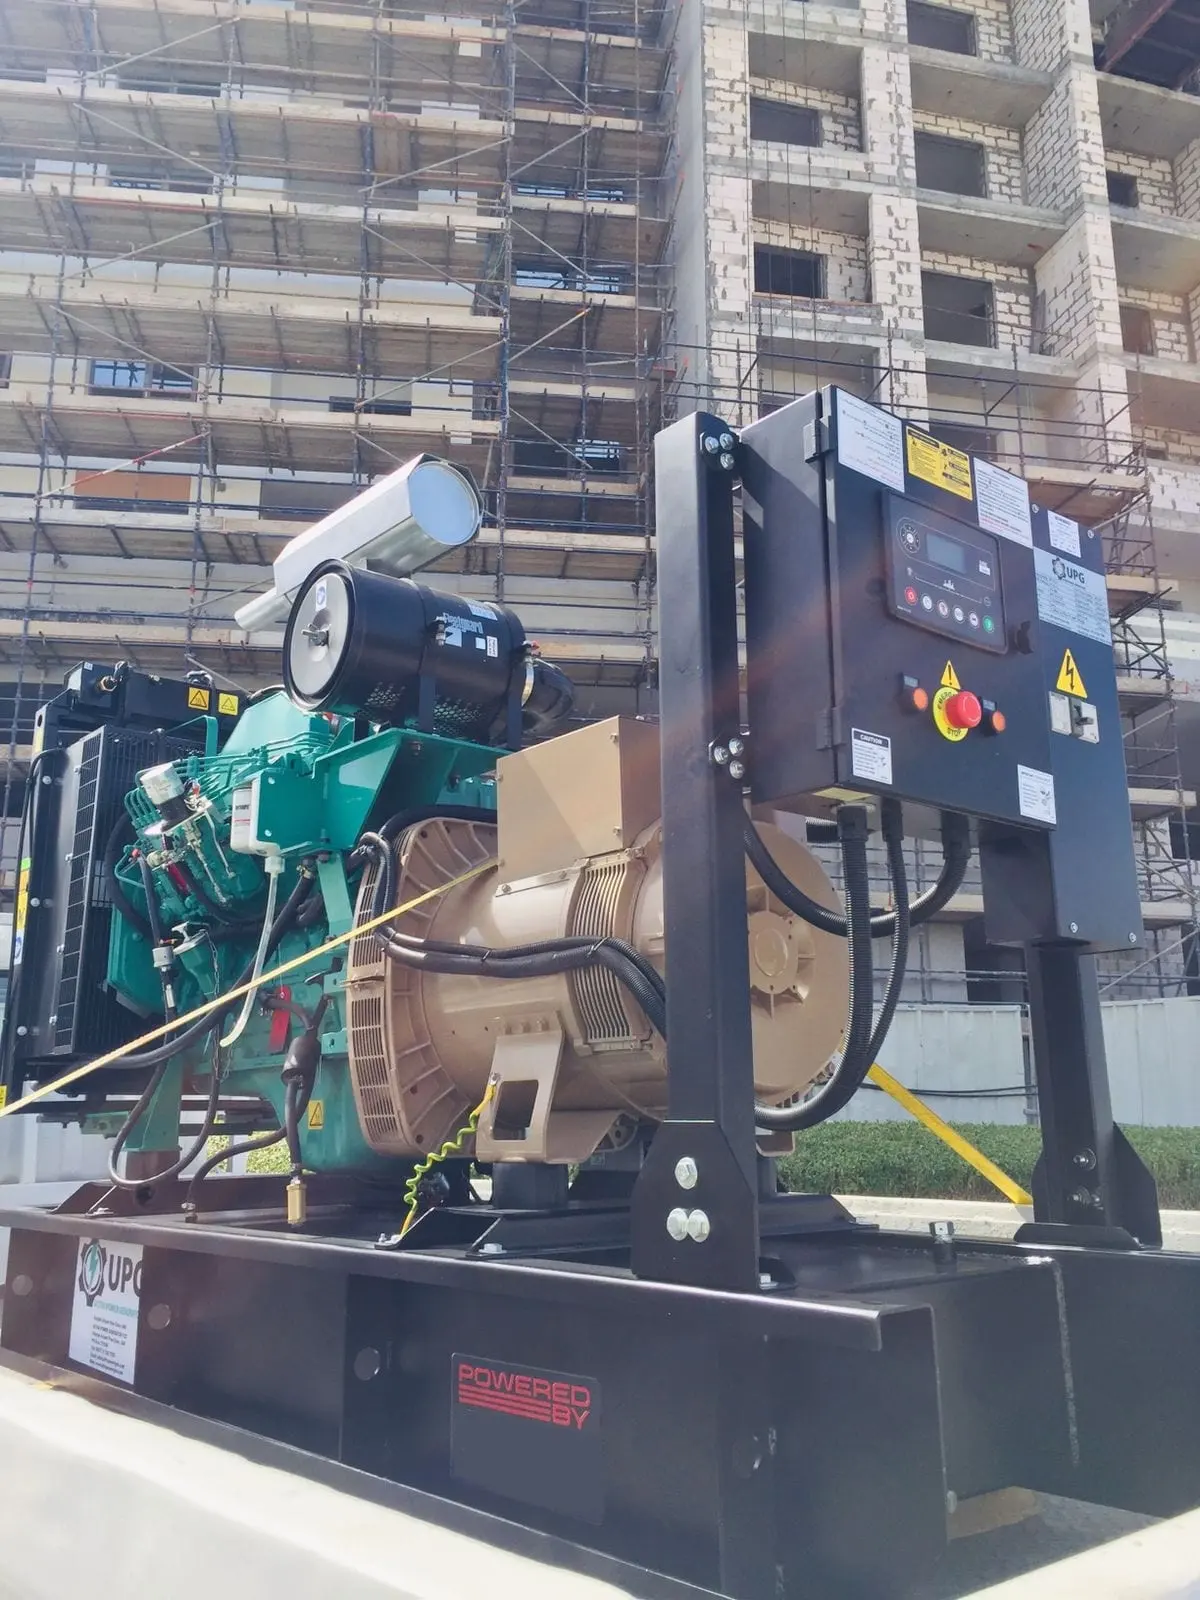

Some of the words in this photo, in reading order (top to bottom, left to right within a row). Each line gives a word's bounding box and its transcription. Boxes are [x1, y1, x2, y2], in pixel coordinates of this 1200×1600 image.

[1066, 566, 1086, 585] UPG
[860, 734, 882, 744] CAUTION
[458, 1363, 591, 1408] POWERED
[552, 1402, 590, 1430] BY
